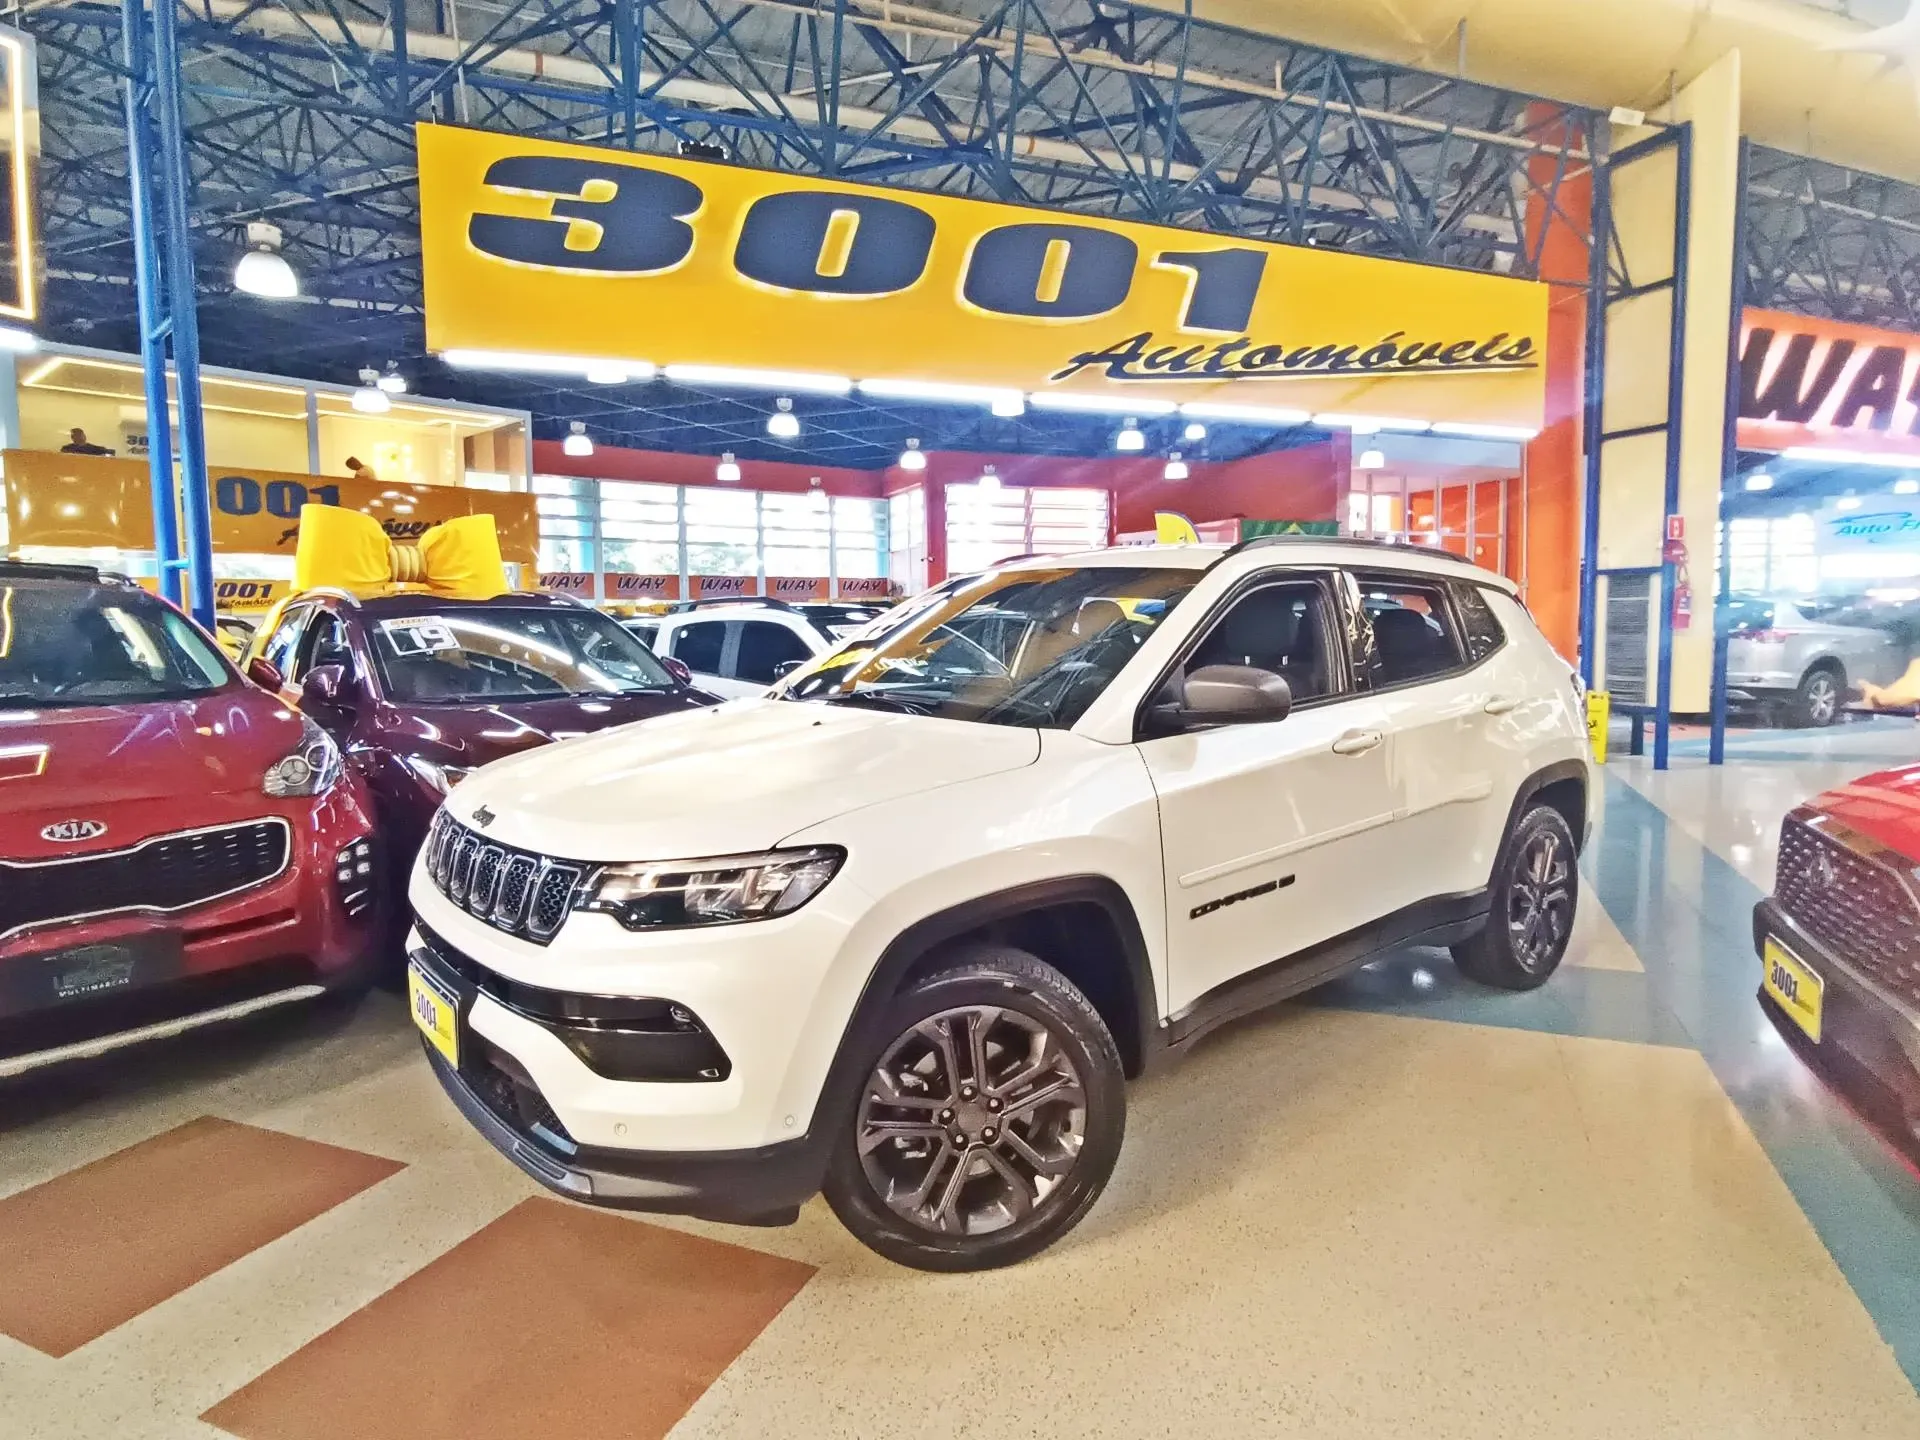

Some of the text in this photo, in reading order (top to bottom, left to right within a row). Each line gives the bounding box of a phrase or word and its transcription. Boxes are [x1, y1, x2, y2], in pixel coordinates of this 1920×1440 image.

[469, 156, 1268, 333] 3001
[1050, 331, 1538, 381] Automóveis
[1738, 327, 1920, 435] WA
[207, 476, 340, 518] 001
[1833, 524, 1891, 536] Auto
[539, 575, 586, 588] WAY
[617, 577, 666, 590] WAY
[700, 578, 745, 591] WAY
[776, 579, 818, 592] WAY
[842, 580, 882, 592] WAY
[214, 582, 273, 599] 001
[53, 821, 98, 839] KIA
[1771, 960, 1798, 1004] 3001
[416, 987, 437, 1031] 3001
